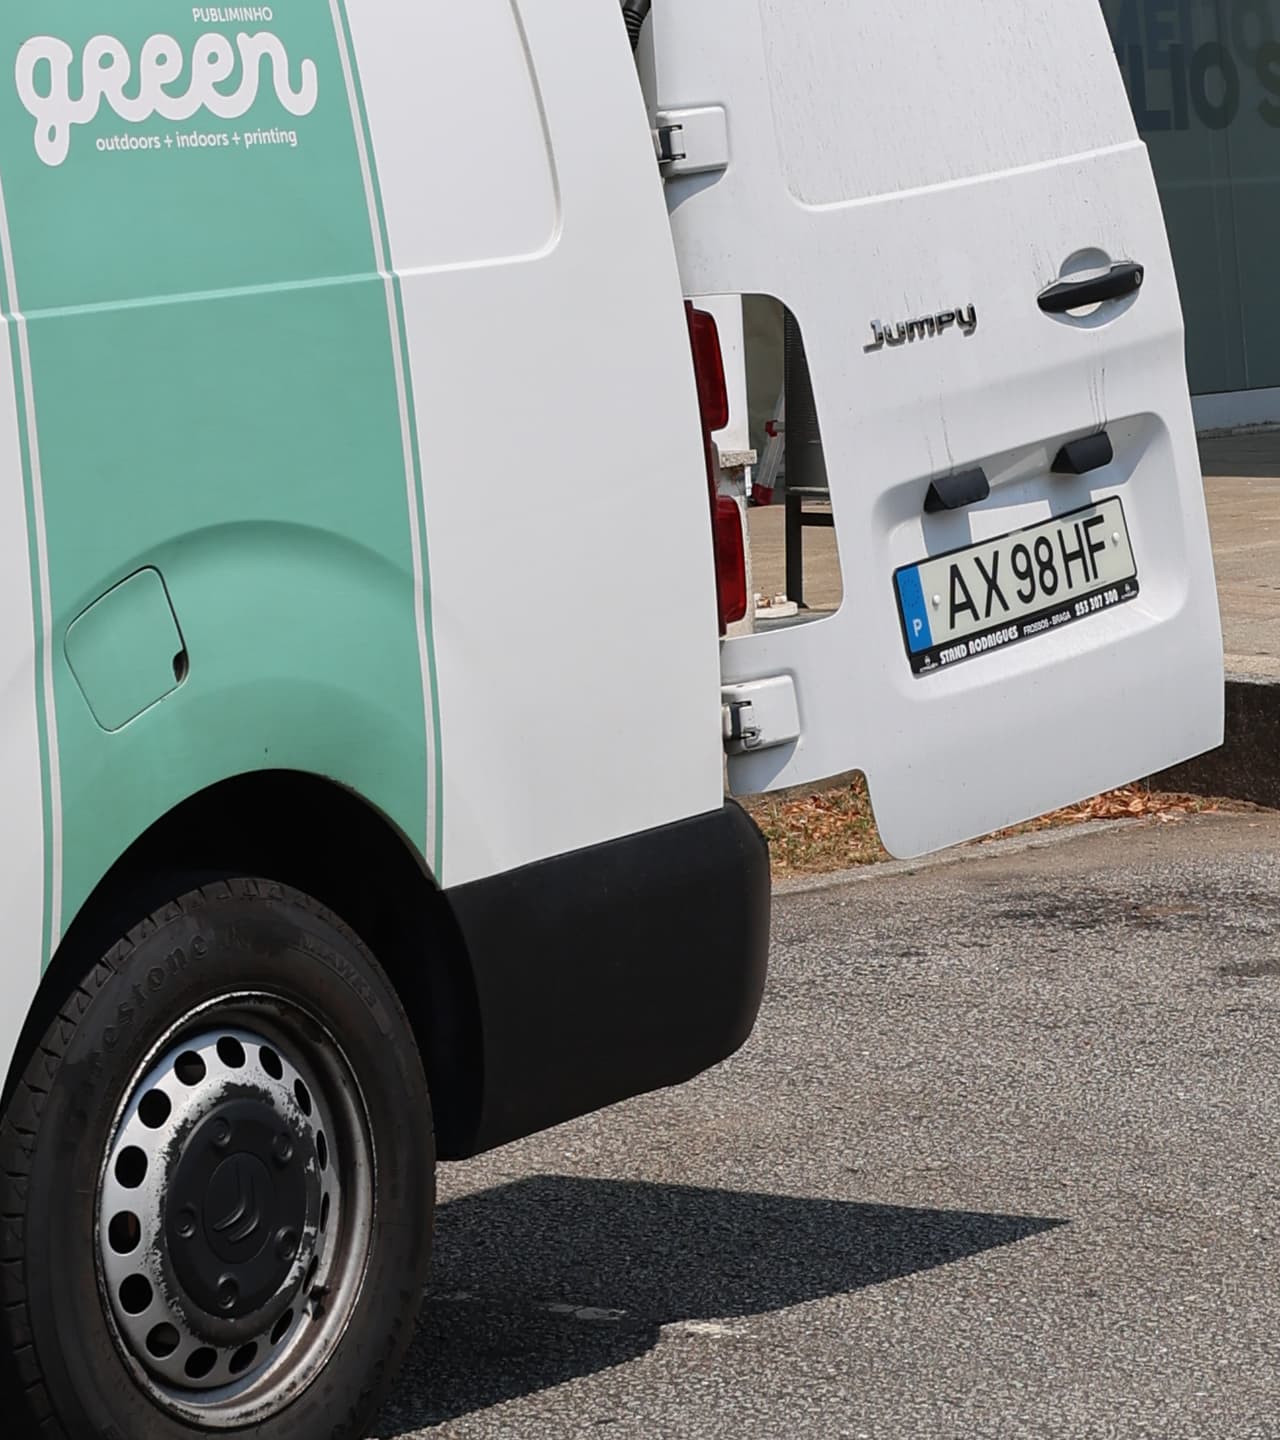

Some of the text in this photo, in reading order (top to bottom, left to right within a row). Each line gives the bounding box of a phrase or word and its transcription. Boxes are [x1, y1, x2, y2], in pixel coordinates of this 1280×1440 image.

[192, 7, 272, 22] PUBLIMINHO
[15, 31, 318, 166] green
[96, 128, 298, 151] outdoors + indoors + printing
[863, 302, 978, 354] Jumpy
[912, 618, 923, 638] P
[939, 644, 968, 665] STAND
[968, 625, 1018, 655] RODRIGUES
[1051, 610, 1072, 626] BRAGA
